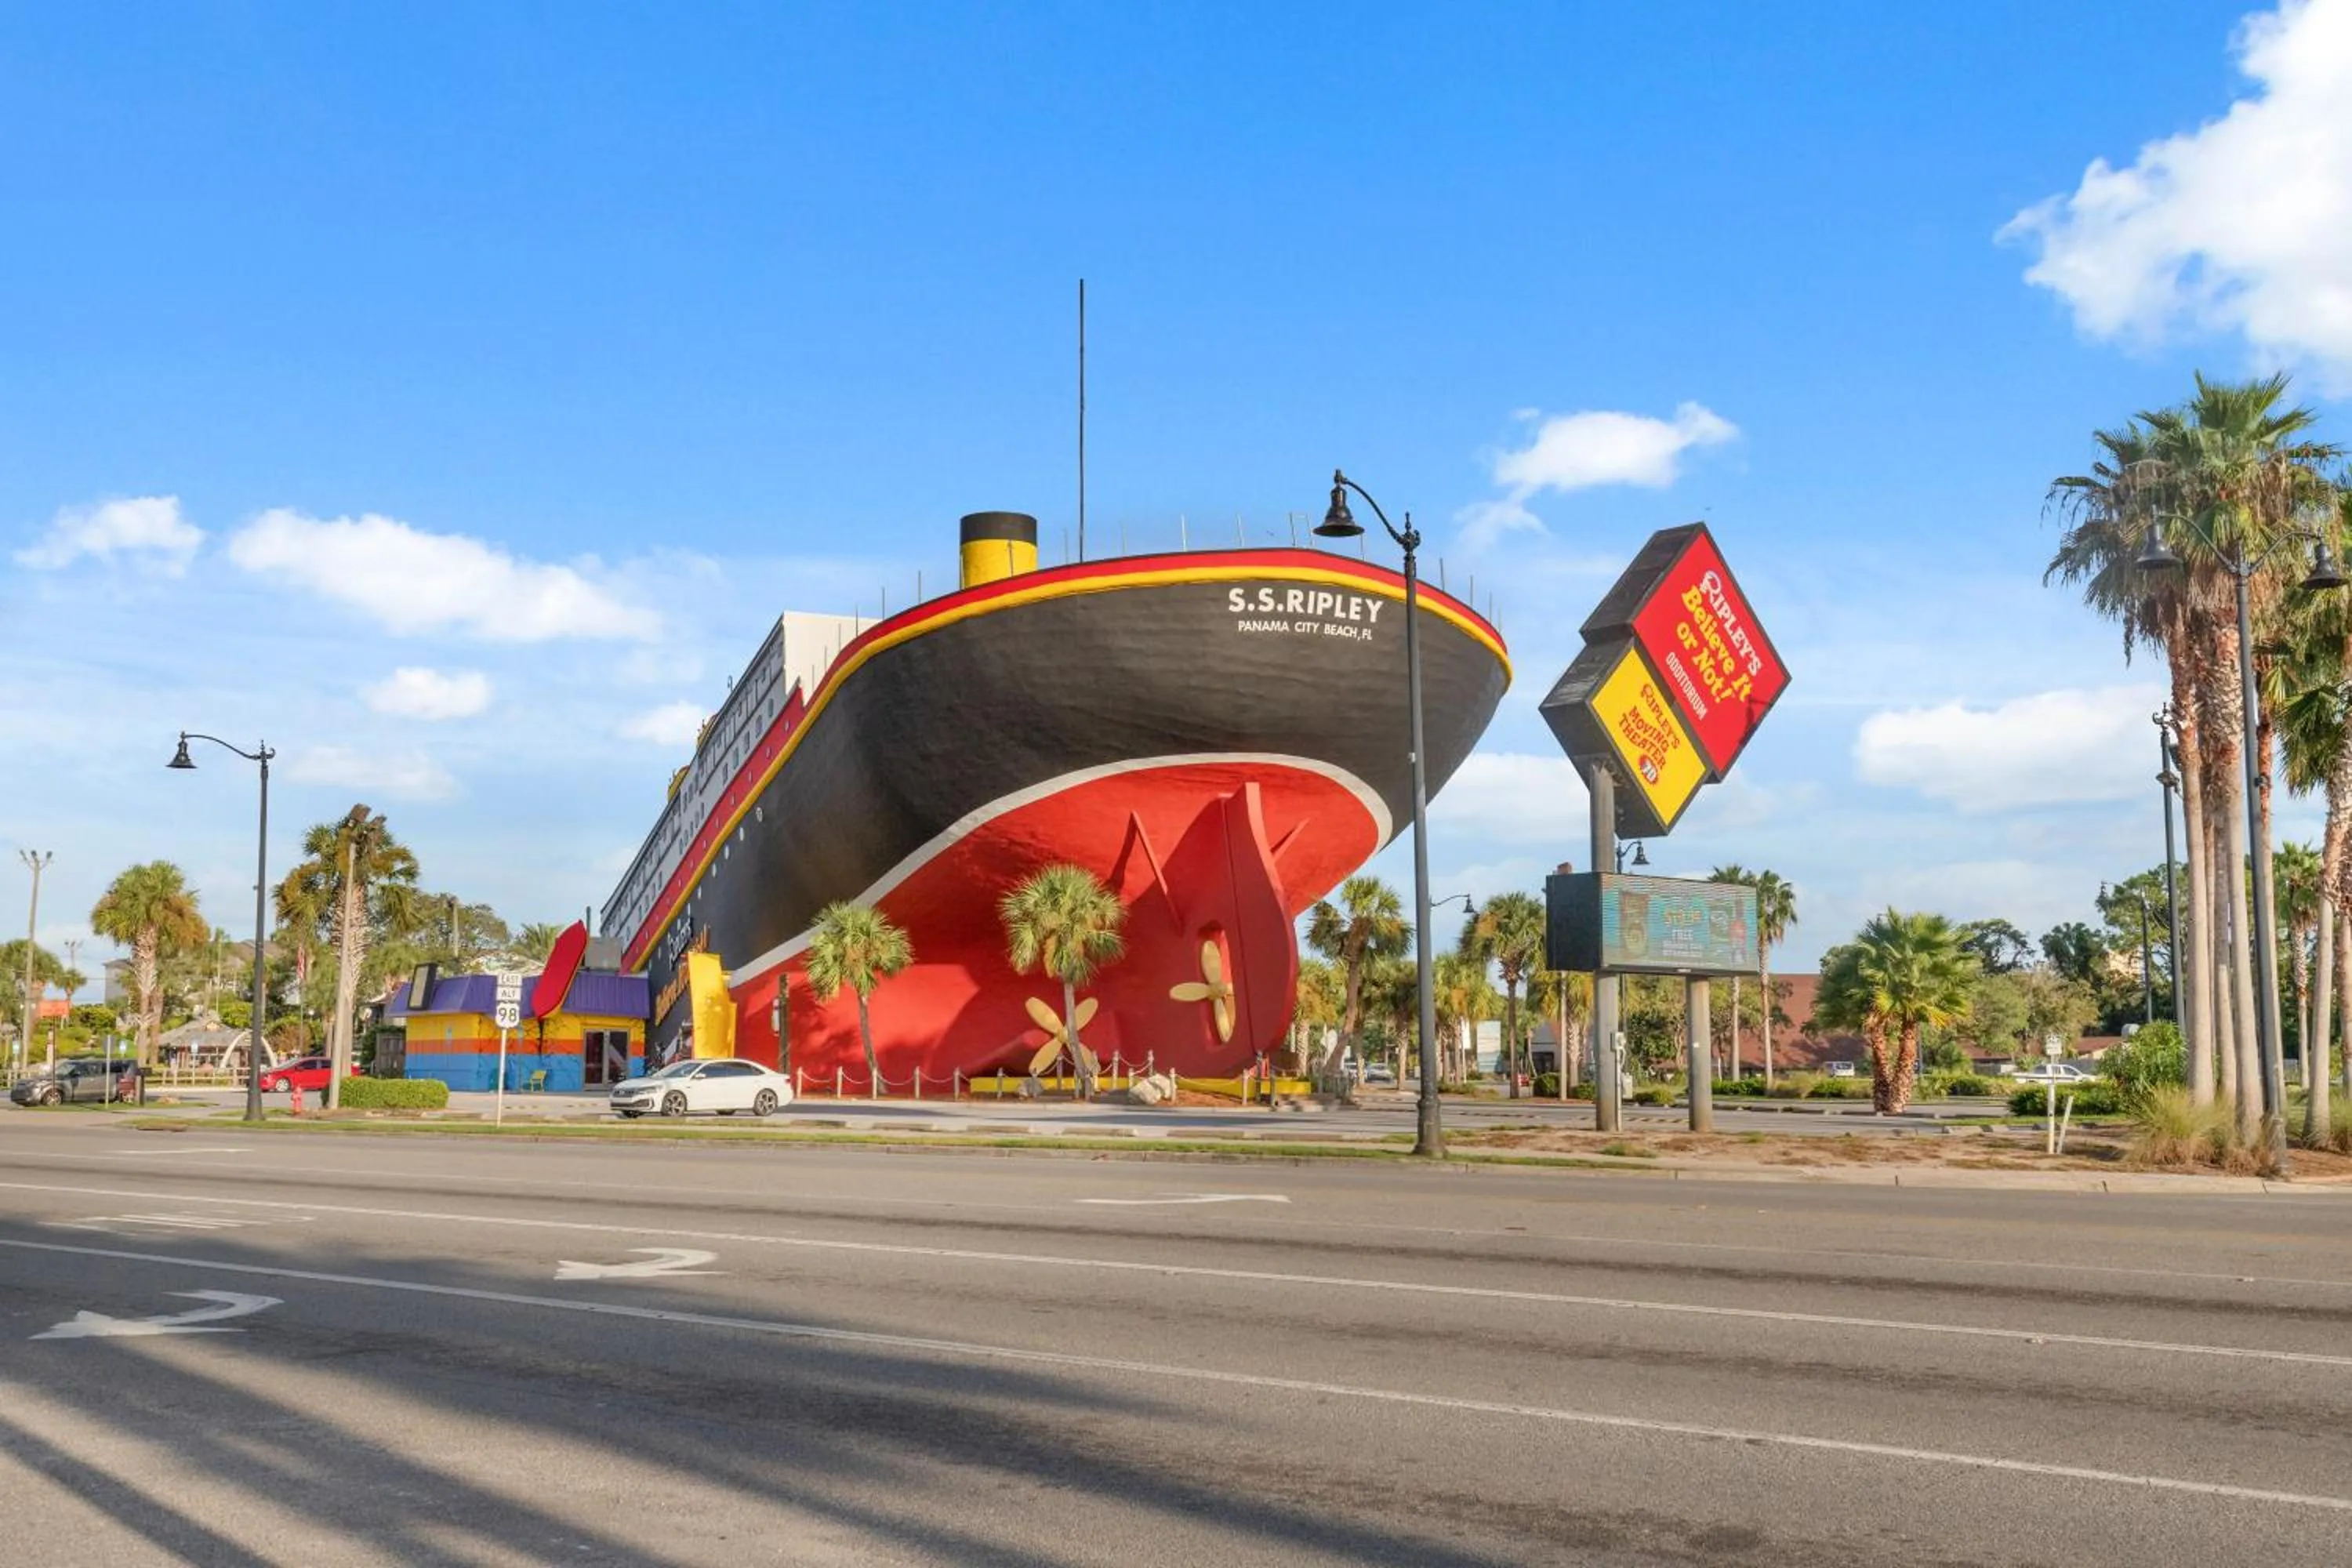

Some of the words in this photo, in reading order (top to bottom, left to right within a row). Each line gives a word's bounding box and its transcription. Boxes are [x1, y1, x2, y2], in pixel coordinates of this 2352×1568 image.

[1238, 620, 1290, 632] PANAMA
[1294, 622, 1320, 633] CITY
[1681, 585, 1735, 675] Believe
[1732, 673, 1753, 702] It
[1700, 570, 1762, 676] RIPLEY'S
[1665, 652, 1709, 720] ODDITORIUM
[1676, 622, 1697, 650] or
[1692, 647, 1733, 703] Not!
[1618, 713, 1666, 770] THEATER
[1628, 706, 1670, 753] MOVING
[1640, 683, 1680, 750] RIPLEY'S
[501, 974, 518, 983] EAST
[499, 1008, 517, 1022] 98
